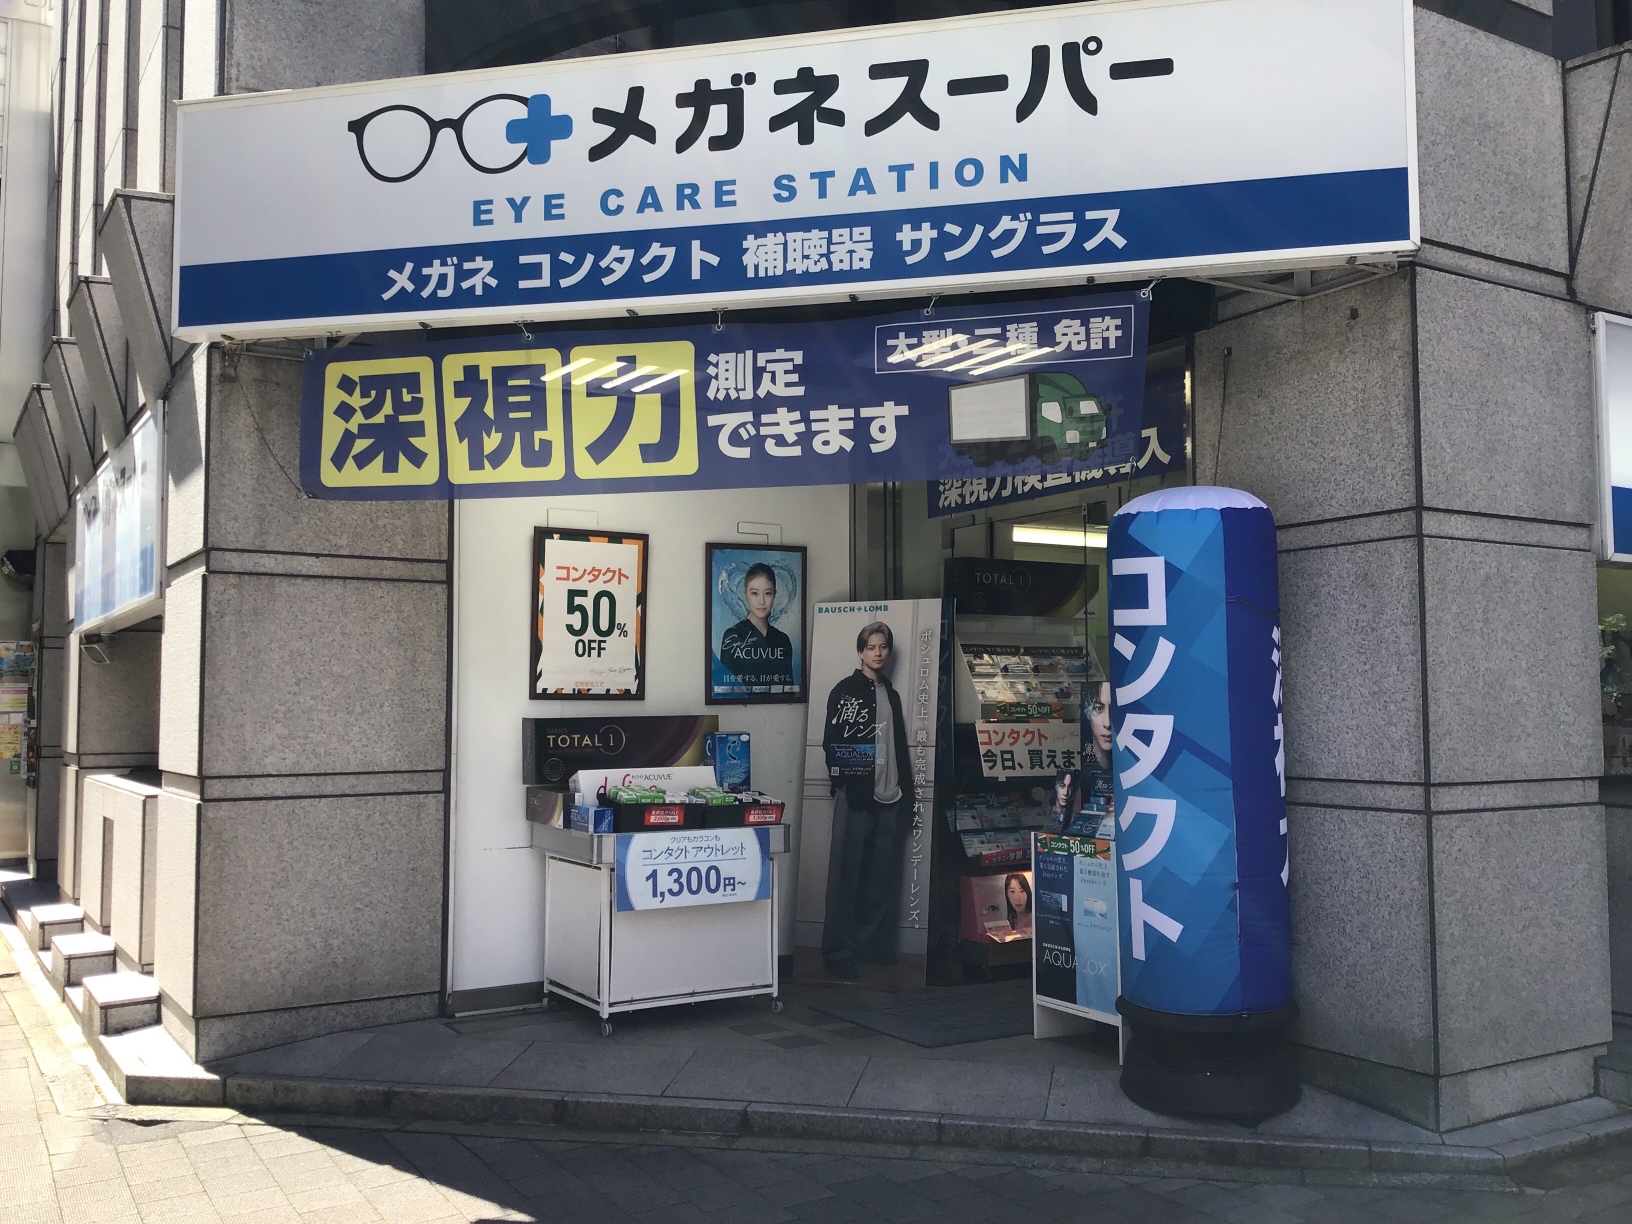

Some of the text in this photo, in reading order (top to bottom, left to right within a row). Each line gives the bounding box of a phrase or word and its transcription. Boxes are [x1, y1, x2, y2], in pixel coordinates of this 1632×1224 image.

[588, 35, 1175, 163] メガネスーパー
[472, 153, 1029, 227] EYE CARE STATION
[381, 208, 1128, 301] メガネ コンタクト 補聴器 サングラス
[1053, 315, 1123, 353] 免許
[706, 348, 806, 402] 測定
[329, 355, 682, 474] 深視力
[706, 400, 910, 459] できます
[555, 565, 630, 586] コンタクト
[974, 572, 1015, 585] TOTAL
[565, 588, 628, 638] 50%
[817, 604, 889, 614] BAUSCH+LOMB
[574, 638, 607, 658] OFF
[733, 647, 785, 660] ACUVUE
[831, 698, 869, 725] 滴る
[546, 733, 603, 748] TOTAL
[843, 721, 888, 739] レンズ
[977, 728, 1049, 747] コンタクト
[1112, 555, 1185, 962] コンタクト
[643, 773, 673, 781] ACUVUE
[670, 835, 721, 845] クリアもカラコンも
[1050, 841, 1069, 850] コンタクト
[1043, 949, 1107, 978] AQUALOX
